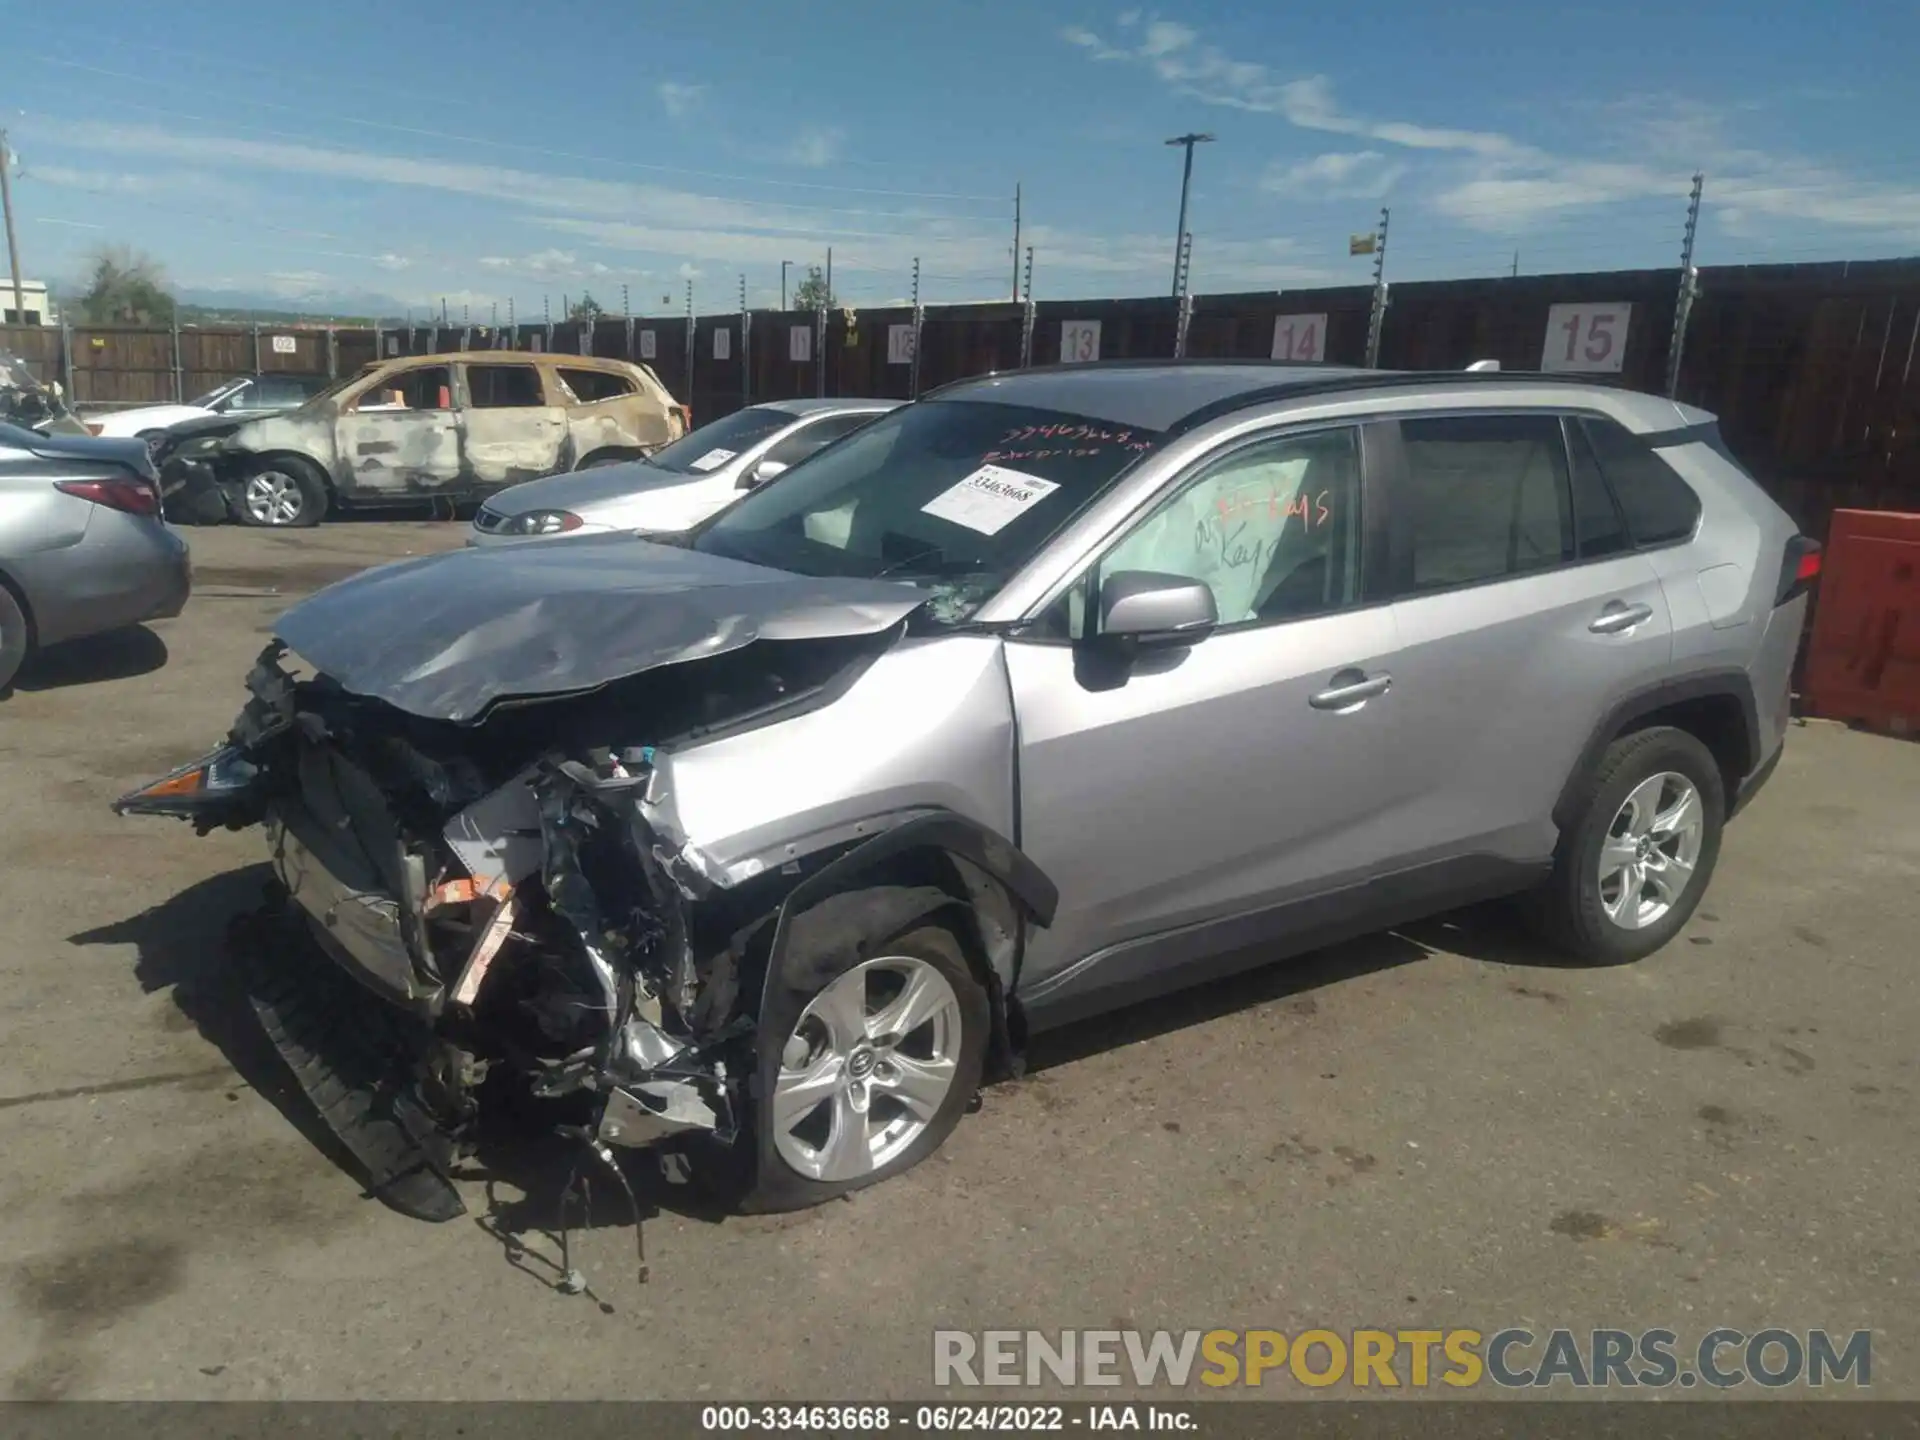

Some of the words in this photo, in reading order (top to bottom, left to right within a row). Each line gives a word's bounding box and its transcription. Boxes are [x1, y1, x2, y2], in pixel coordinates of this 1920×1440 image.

[1068, 327, 1093, 361] 13
[1282, 322, 1316, 361] 14
[1562, 313, 1614, 362] 15
[968, 475, 1034, 502] 33463668
